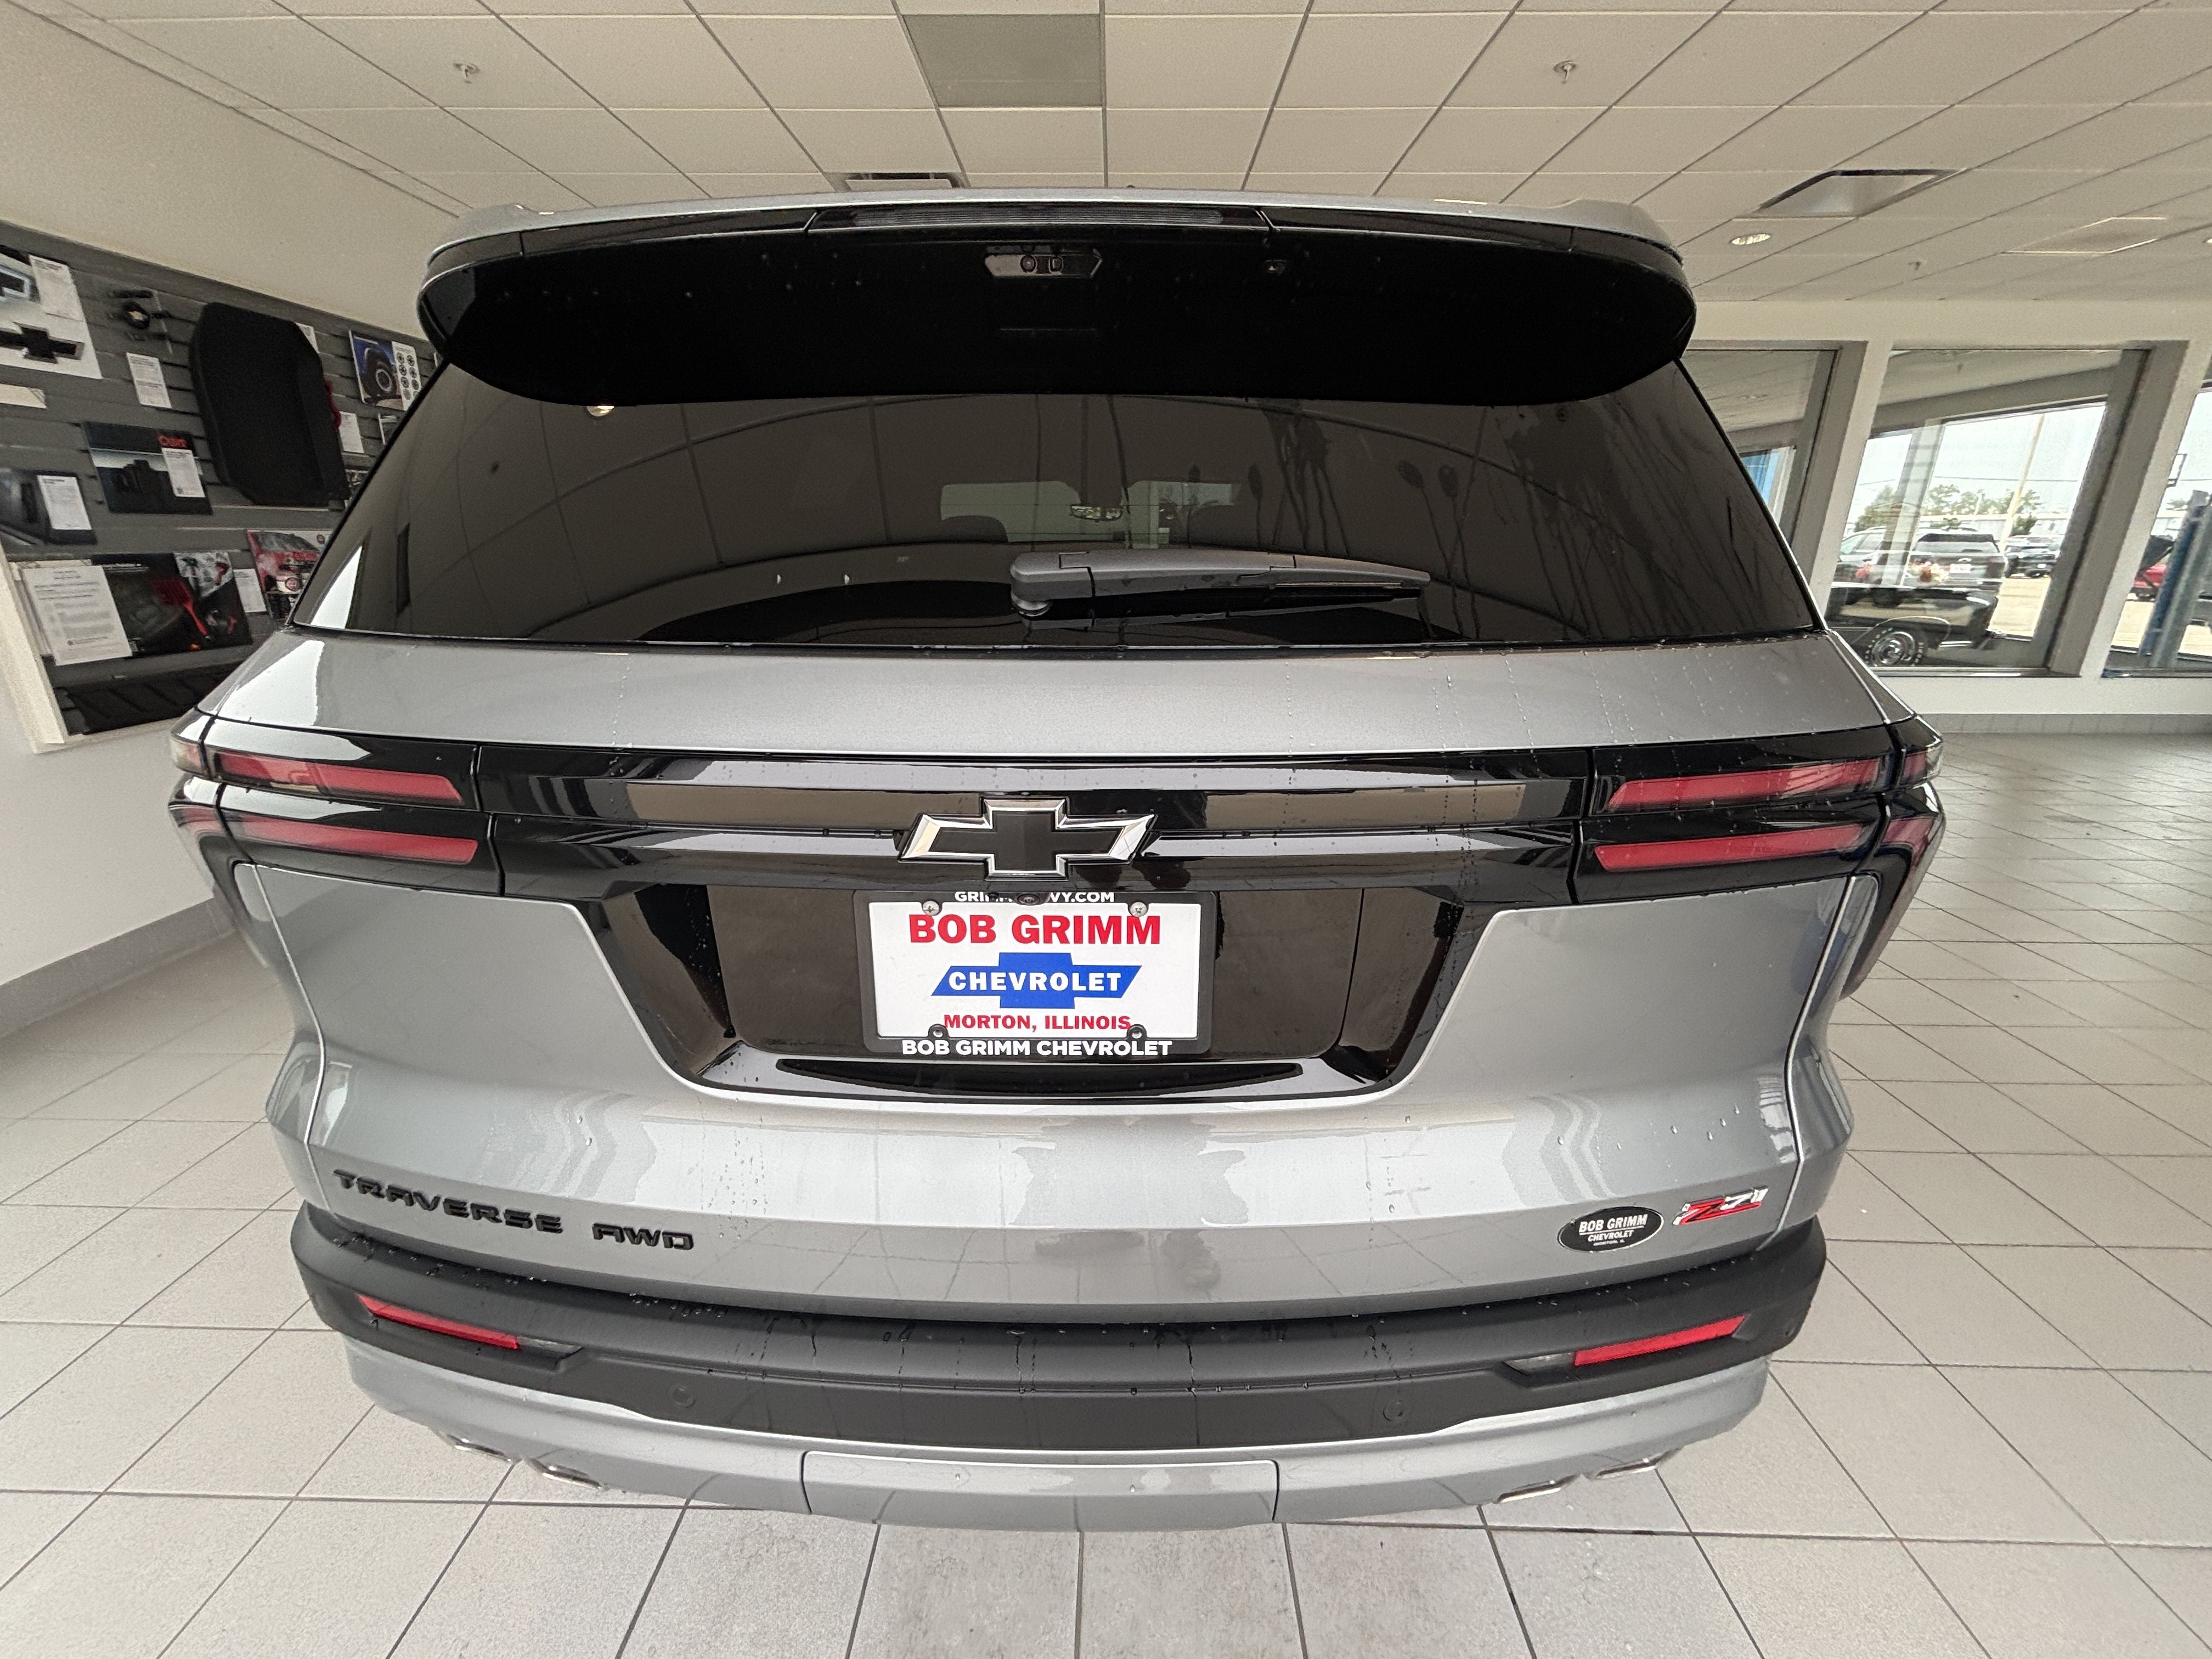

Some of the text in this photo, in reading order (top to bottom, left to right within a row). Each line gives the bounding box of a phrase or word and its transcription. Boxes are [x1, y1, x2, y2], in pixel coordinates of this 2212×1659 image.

[955, 891, 1115, 902] GRIVY.COM
[909, 914, 1160, 945] BOB GRIMM
[949, 972, 1121, 991] CHEVROLET
[944, 1014, 1131, 1032] MORTON, ILLINOIS
[902, 1040, 1172, 1056] BOB GRIMM CHEVROLET
[334, 1169, 695, 1251] TRAVERSE AWD
[1672, 1187, 1769, 1226] Z71
[1579, 1214, 1648, 1233] BOB GRIMM
[1588, 1229, 1634, 1242] CHEVROLET
